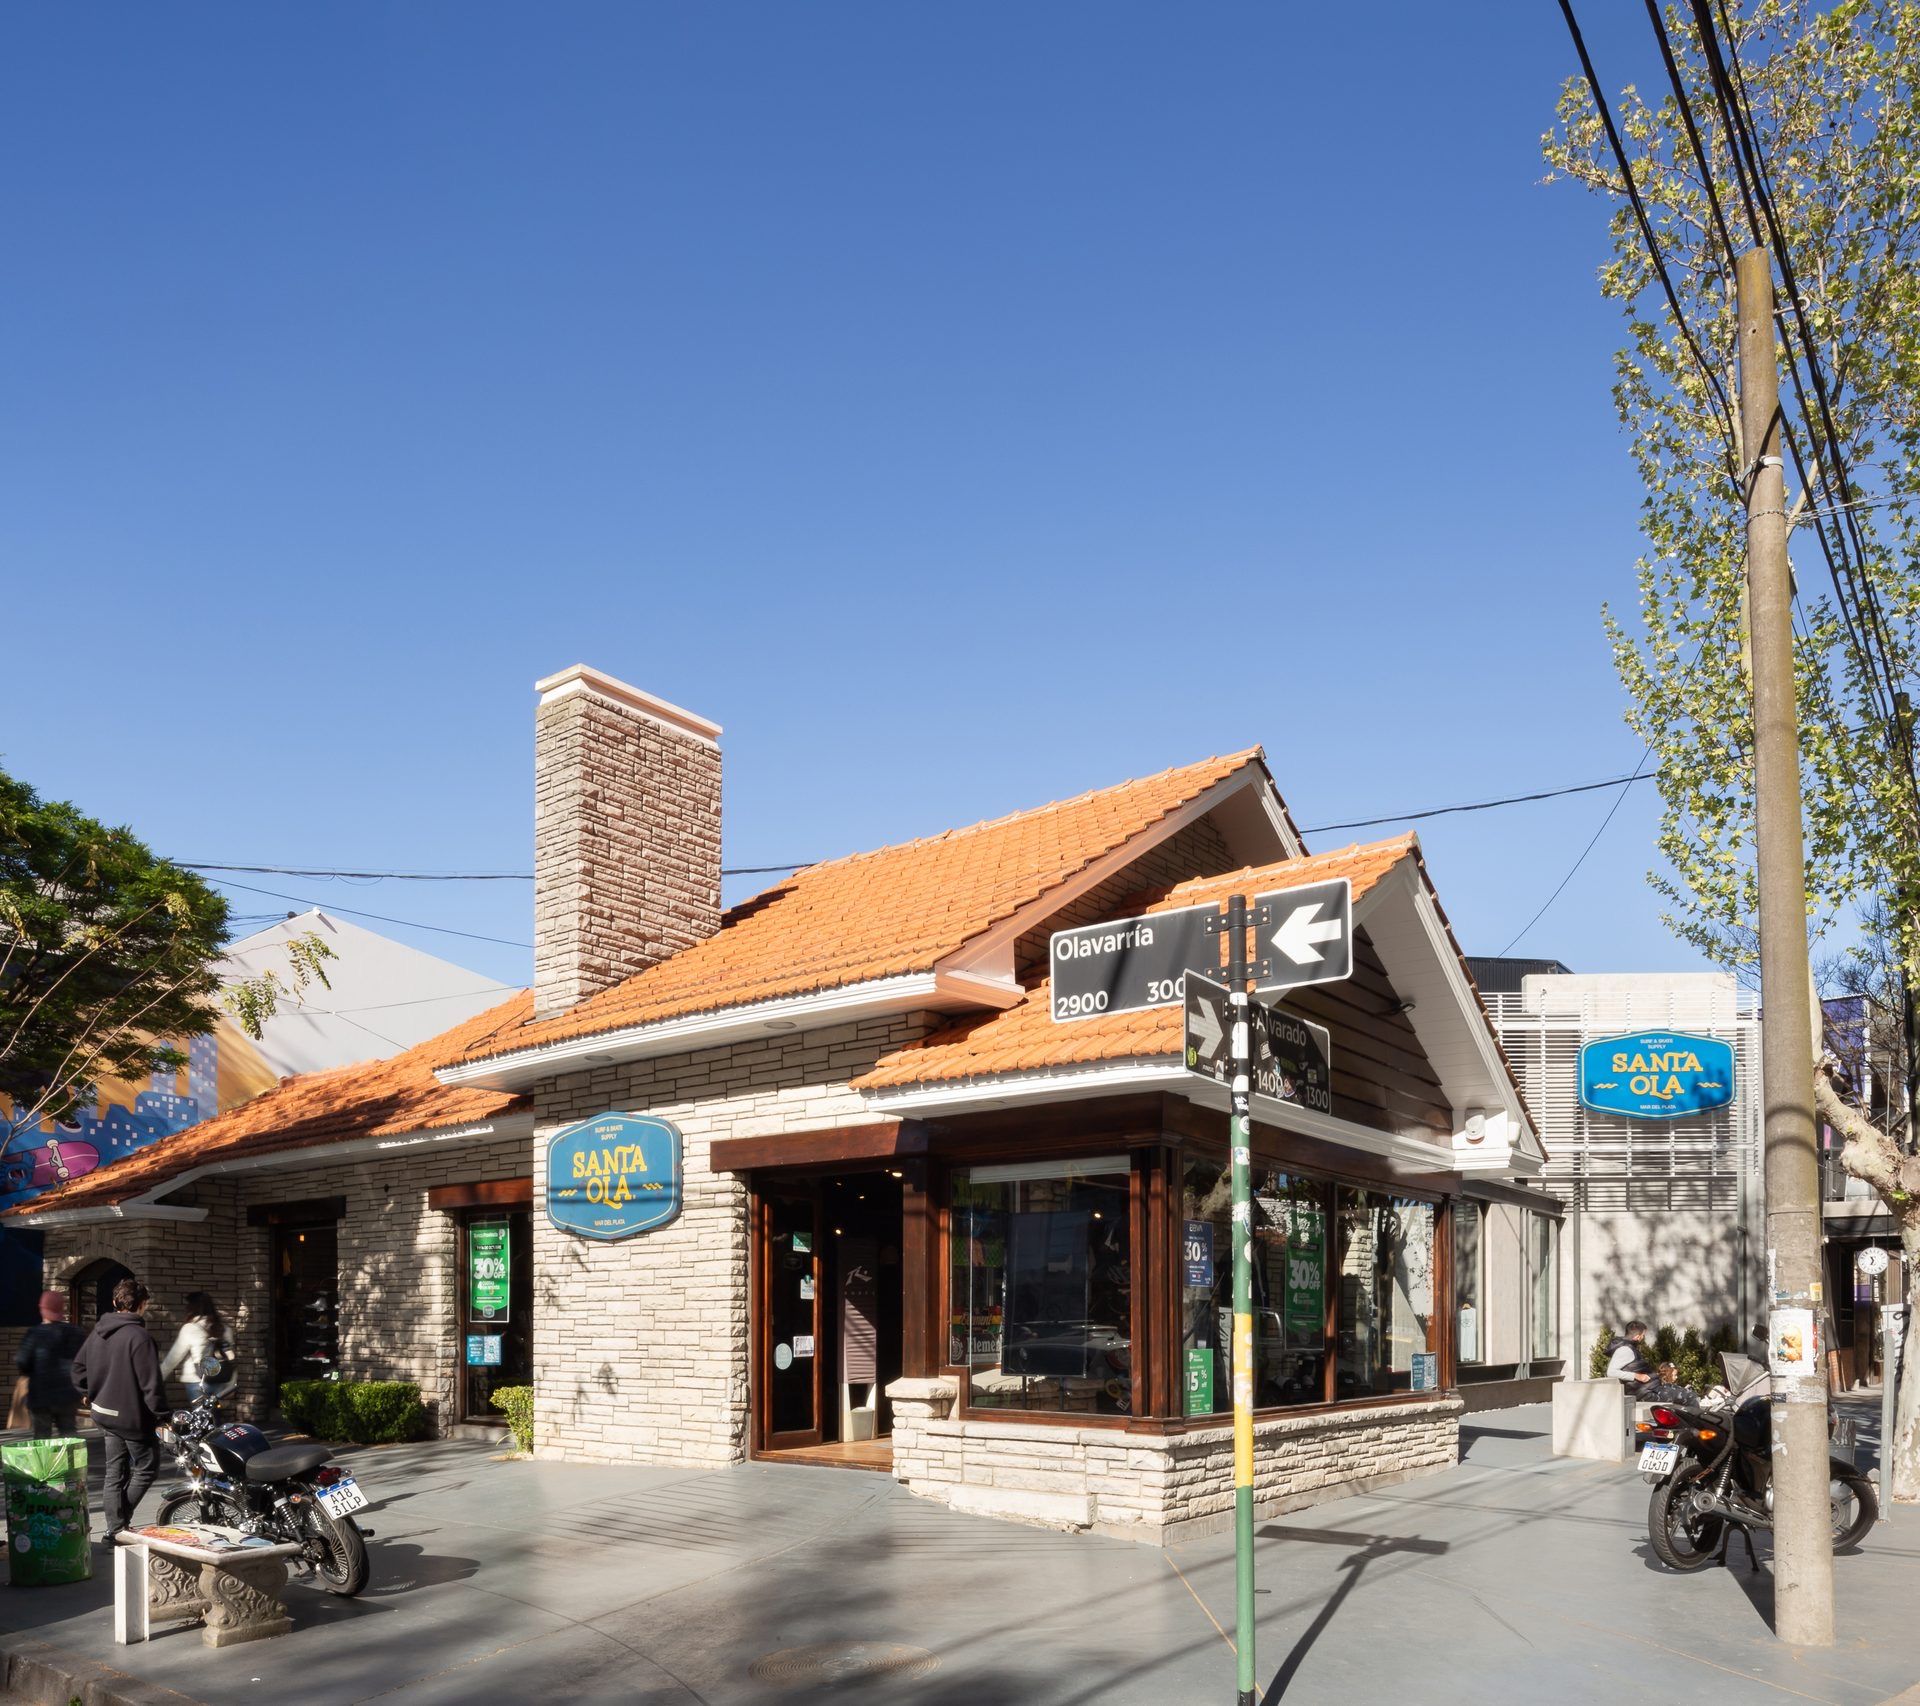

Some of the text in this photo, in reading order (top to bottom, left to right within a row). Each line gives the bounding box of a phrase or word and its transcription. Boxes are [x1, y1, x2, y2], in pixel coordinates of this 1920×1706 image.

[1056, 924, 1154, 961] Olavarría
[1057, 977, 1185, 1018] 2900 300
[1256, 1010, 1307, 1047] Alvarado
[1612, 1051, 1704, 1073] SANTA
[1257, 1069, 1329, 1109] 1400 1300
[1630, 1075, 1685, 1100] OLA
[572, 1144, 648, 1179] SANTA
[586, 1175, 632, 1209] OLA
[493, 1271, 506, 1279] OFF
[1308, 1280, 1320, 1290] OFF
[330, 1487, 353, 1504] A18
[332, 1496, 362, 1516] 3ILP
